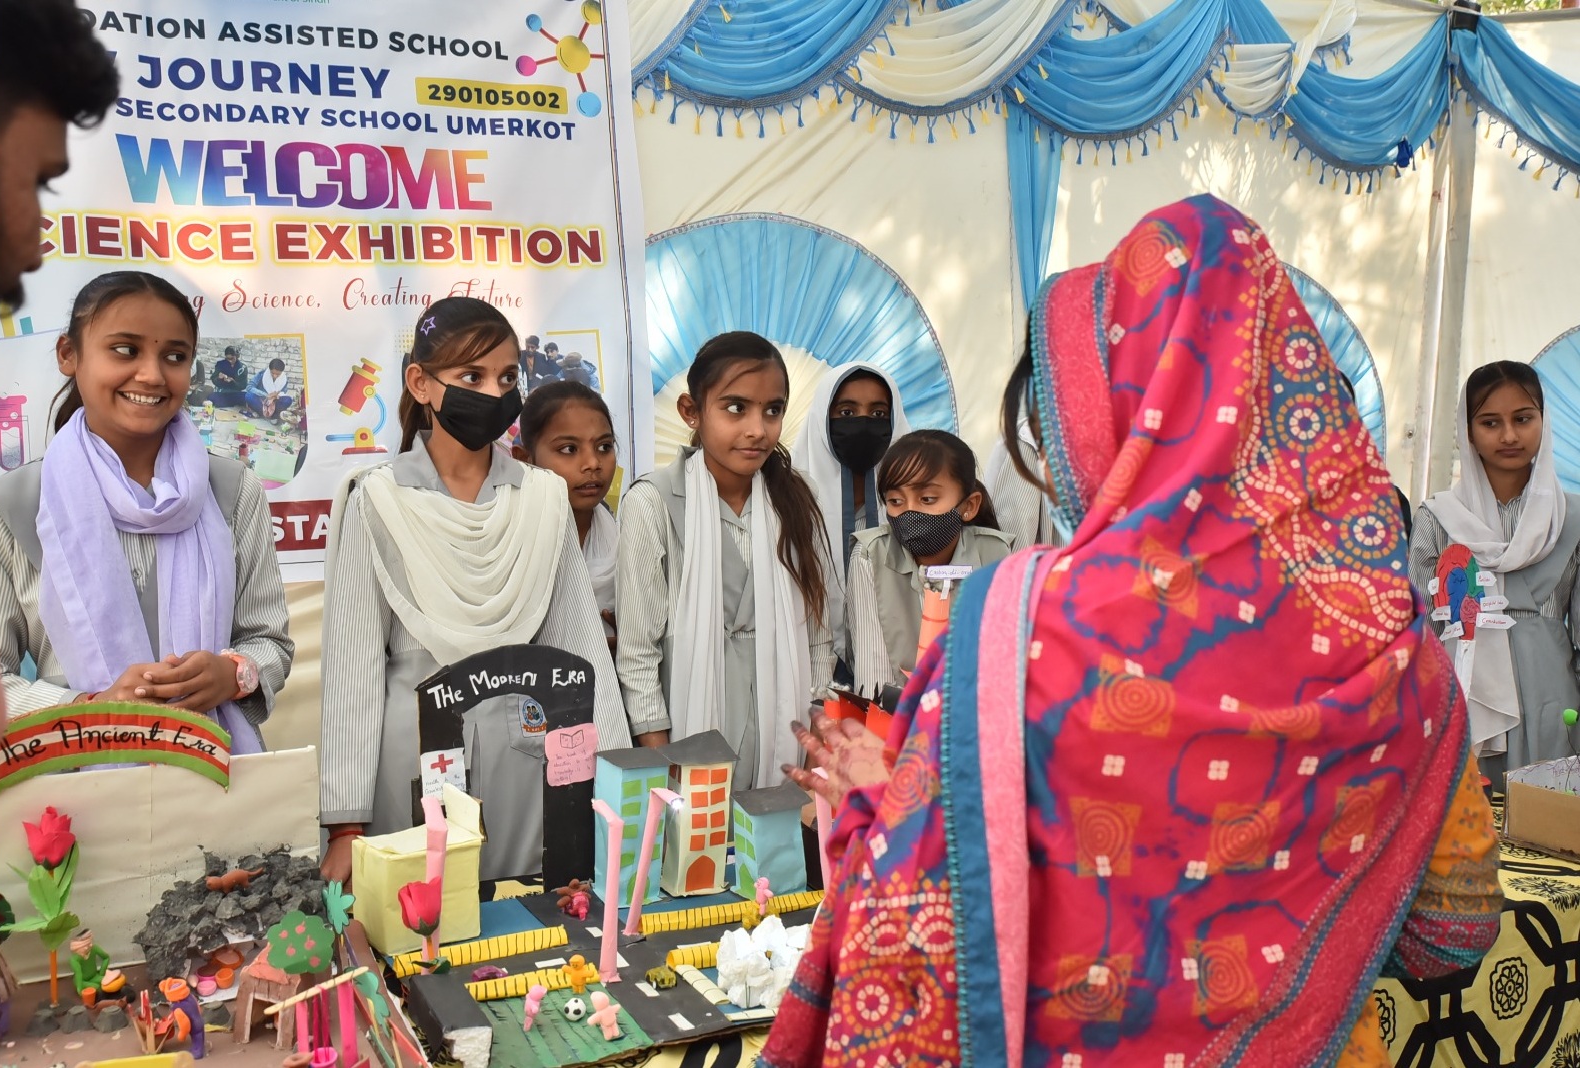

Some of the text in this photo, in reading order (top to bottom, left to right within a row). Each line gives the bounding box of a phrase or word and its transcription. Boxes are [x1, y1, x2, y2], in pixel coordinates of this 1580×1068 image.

[218, 20, 378, 50] ASSISTED
[388, 31, 509, 61] SCHOOL
[137, 54, 390, 99] JOURNEY
[427, 84, 560, 109] 290105002
[115, 97, 576, 141] SECONDARY SCHOOL UMERKOT
[115, 133, 493, 211] WELCOME
[275, 222, 604, 266] EXHIBITION
[221, 279, 321, 313] Science,
[342, 276, 433, 310] Creating
[171, 725, 218, 756] Era
